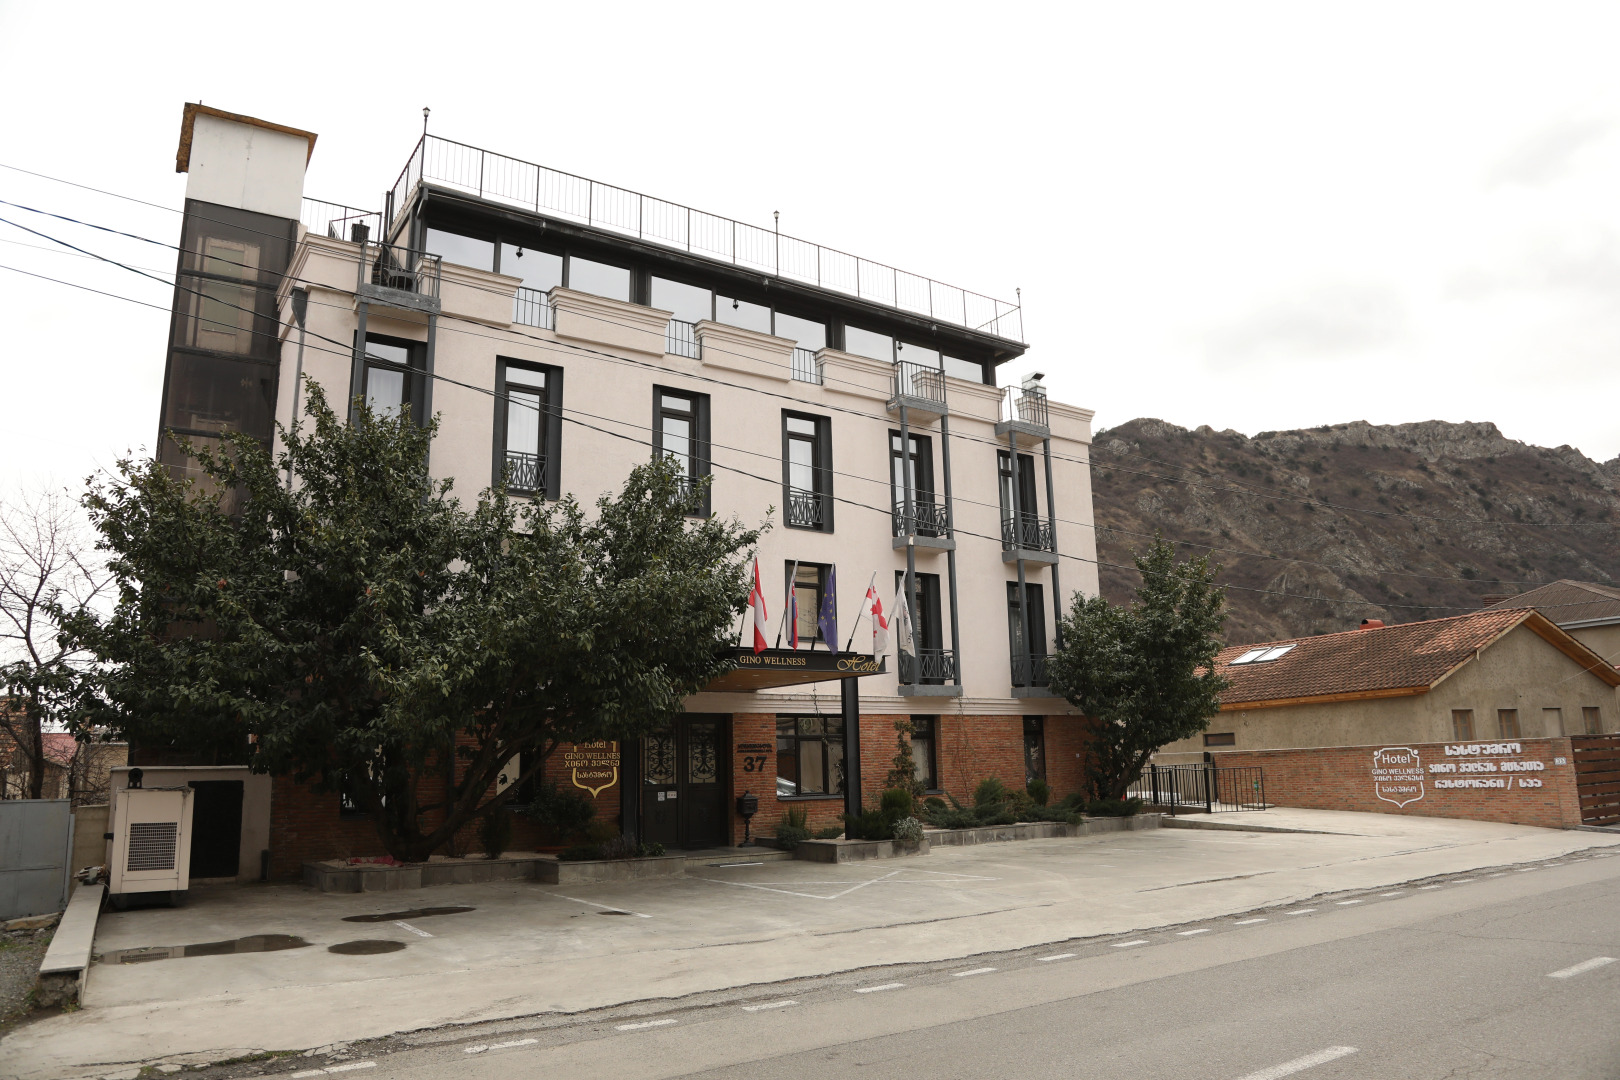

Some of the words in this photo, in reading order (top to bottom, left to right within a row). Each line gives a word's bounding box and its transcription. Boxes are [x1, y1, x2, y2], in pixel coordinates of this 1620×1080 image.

[739, 656, 761, 664] GINO
[763, 656, 806, 666] WELLNESS
[836, 656, 880, 672] Hotel
[1444, 743, 1521, 756] სასტუმრო
[564, 752, 584, 760] GINO
[586, 752, 620, 760] WELLNES
[1382, 753, 1410, 764] Hotel
[564, 760, 588, 768] ჯინო
[743, 756, 767, 772] 37
[1429, 763, 1457, 773] ჯინო
[1434, 779, 1505, 789] რესტორანი
